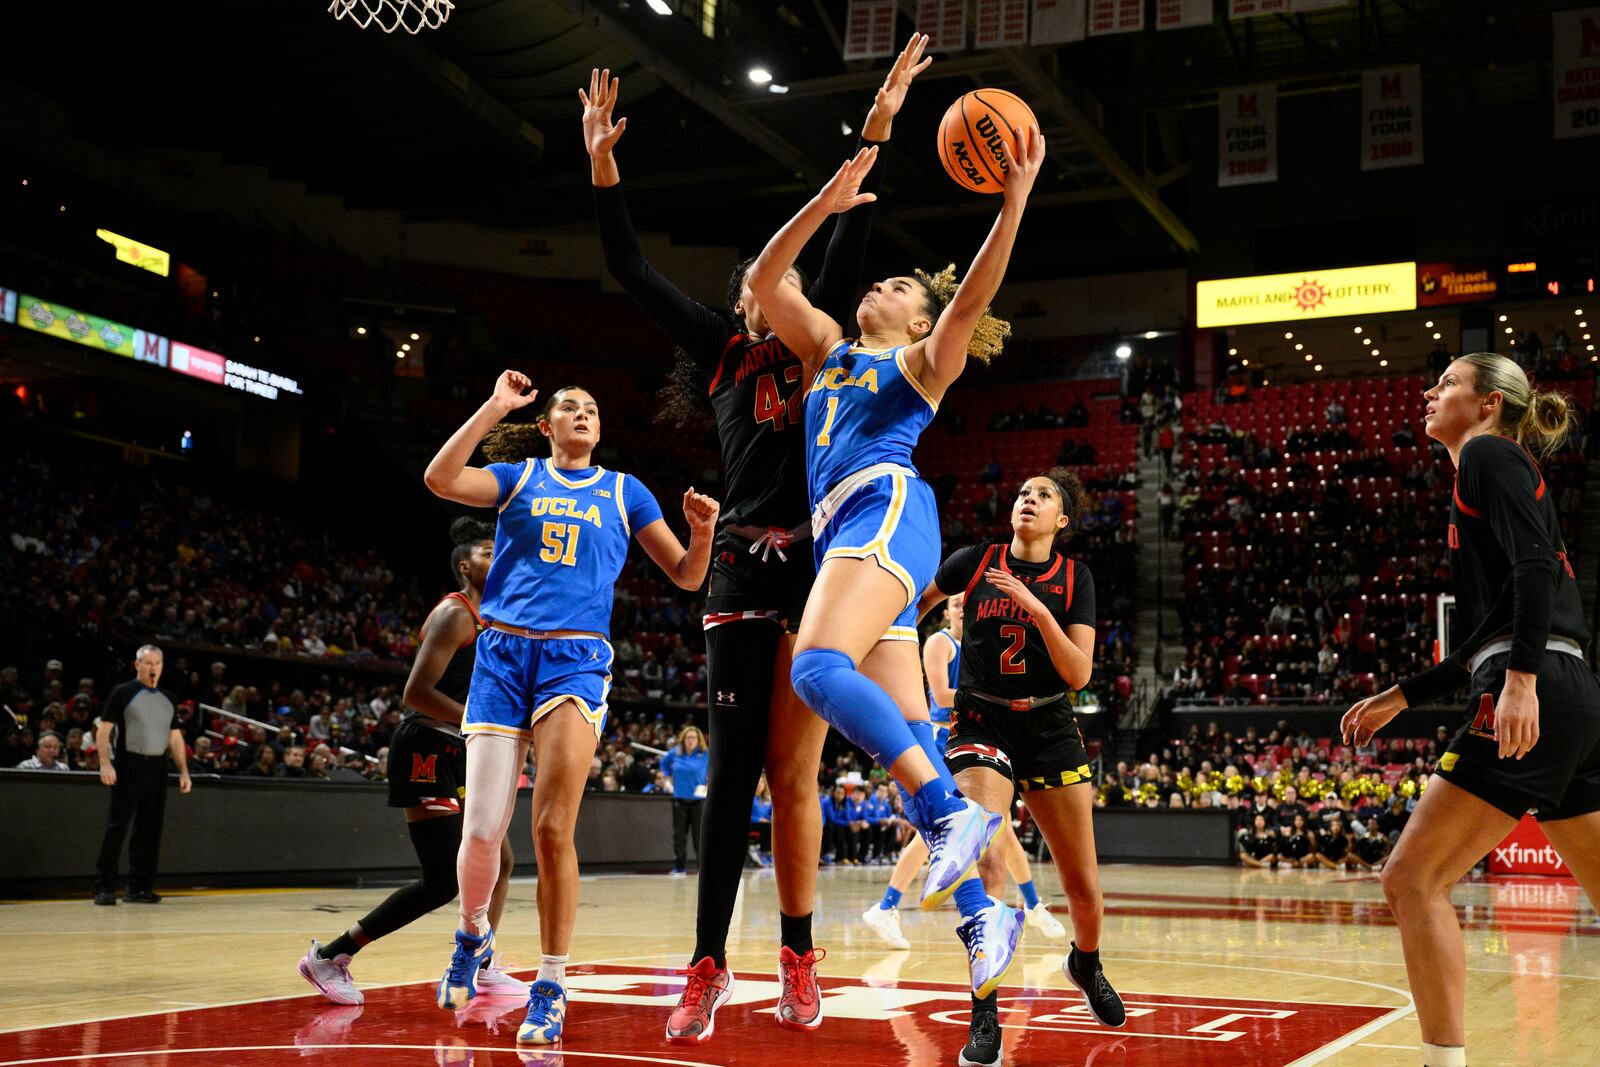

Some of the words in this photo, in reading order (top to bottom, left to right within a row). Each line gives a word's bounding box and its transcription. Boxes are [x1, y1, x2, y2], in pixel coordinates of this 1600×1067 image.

[1380, 75, 1402, 99] M
[1369, 106, 1412, 122] FINAL
[1226, 125, 1268, 139] FINAL
[1371, 121, 1411, 136] FOUR
[975, 113, 1010, 175] Wilso
[1228, 137, 1267, 153] FOUR
[951, 140, 987, 186] NCAA
[1442, 270, 1488, 288] planet
[1447, 281, 1497, 295] fitness
[1216, 292, 1292, 309] MARYLAND
[1329, 283, 1393, 299] LOTTERY
[754, 366, 803, 432] 42
[816, 396, 839, 447] 1
[530, 496, 602, 529] UCLA
[539, 521, 580, 567] 51
[1000, 624, 1026, 675] 2
[410, 752, 438, 780] M
[1494, 842, 1563, 870] xfinity
